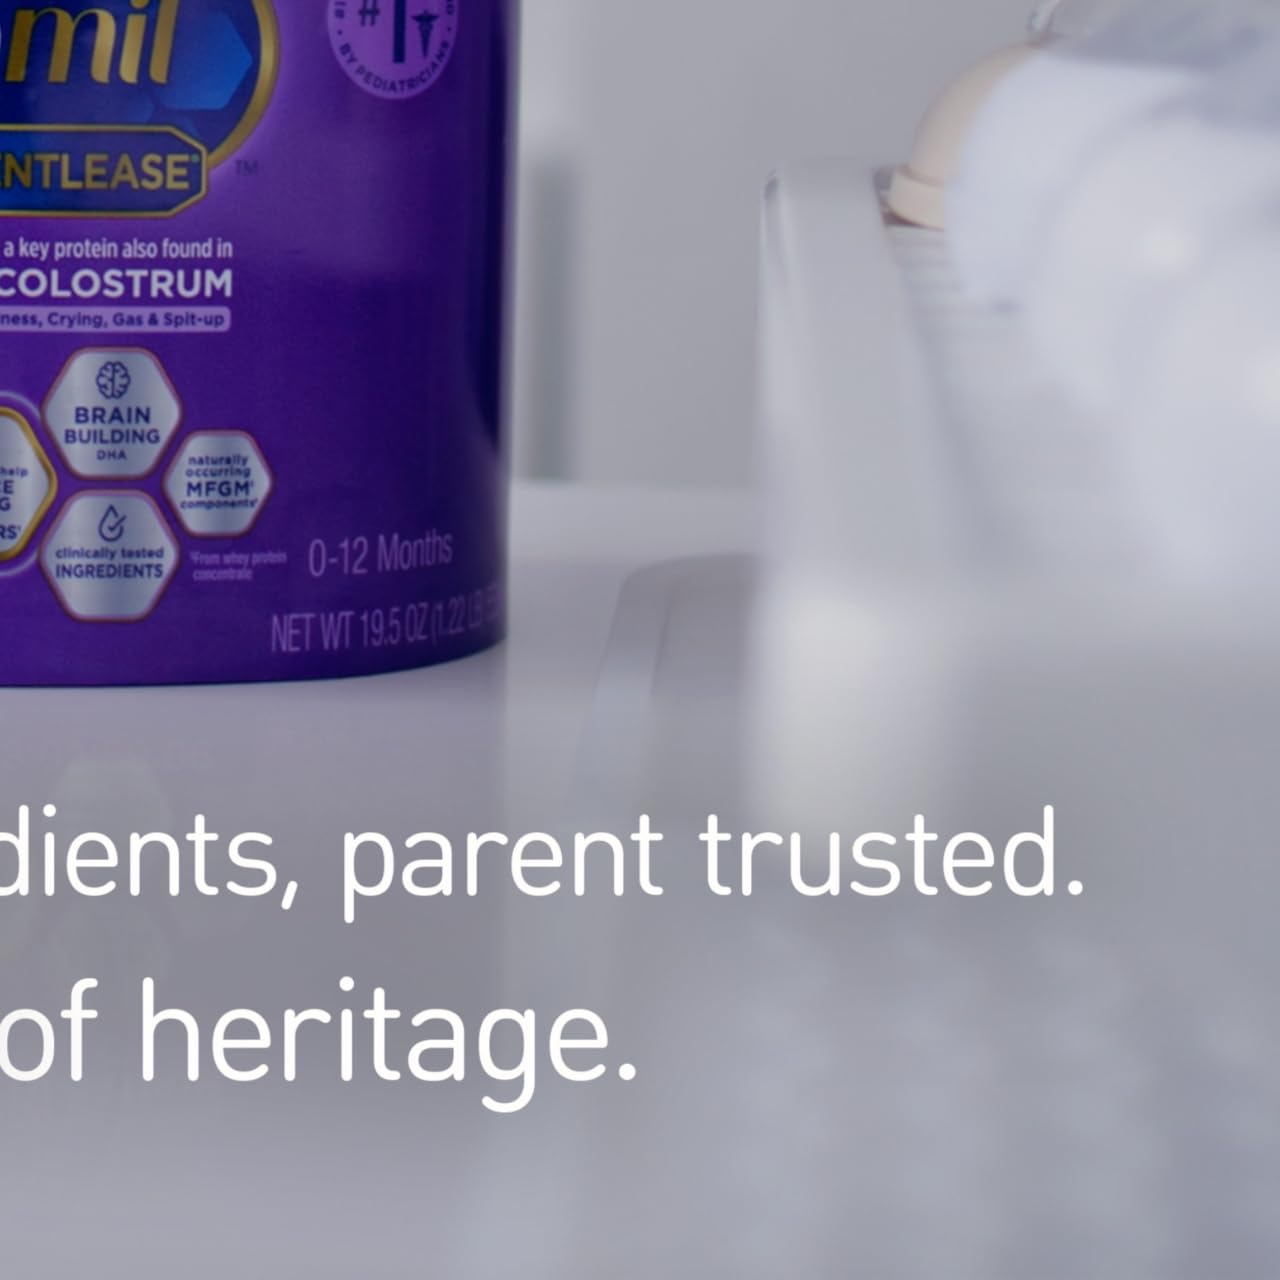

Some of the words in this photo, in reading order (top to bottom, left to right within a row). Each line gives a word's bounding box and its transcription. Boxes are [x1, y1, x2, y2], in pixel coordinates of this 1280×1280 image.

[339, 42, 358, 64] BY
[356, 40, 450, 93] PEDIATRICIANS
[3, 240, 14, 257] a
[19, 237, 49, 260] key
[54, 237, 118, 261] protein
[122, 237, 158, 258] also
[161, 237, 213, 258] found
[216, 237, 232, 258] in
[47, 311, 108, 329] Crying,
[113, 312, 144, 326] Gas
[147, 312, 159, 326] &
[163, 312, 225, 330] Spit-up
[74, 406, 151, 424] BRAIN
[64, 429, 160, 444] BUILDING
[96, 450, 127, 460] DHA
[188, 453, 248, 467] naturally
[185, 465, 251, 479] occurring
[55, 547, 116, 561] clinically
[121, 548, 164, 559] tested
[308, 536, 369, 576] 0-12
[377, 528, 453, 573] Months
[55, 563, 164, 579] INGREDIENTS
[272, 613, 316, 652] NET
[320, 611, 356, 650] WT
[361, 607, 402, 647] 19.5
[405, 602, 429, 643] OZ
